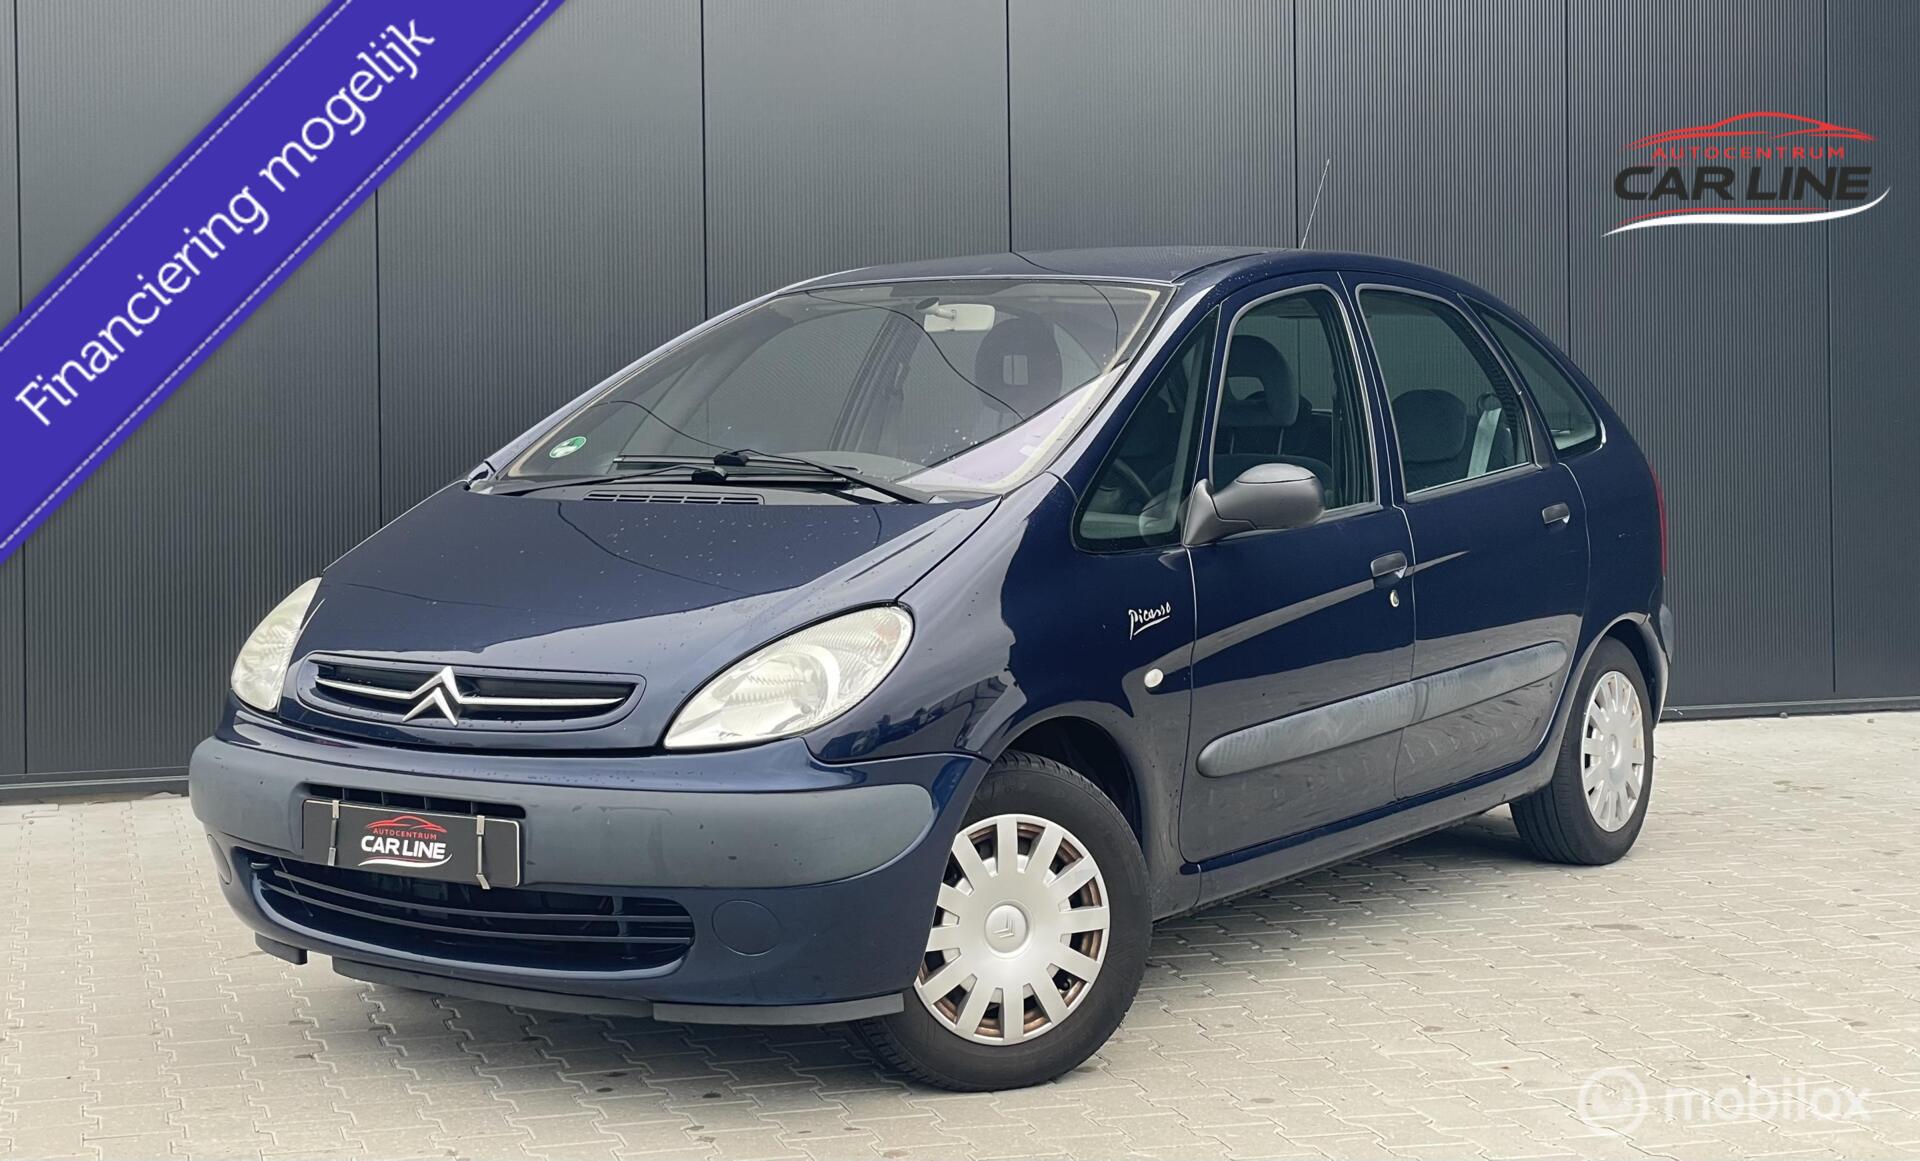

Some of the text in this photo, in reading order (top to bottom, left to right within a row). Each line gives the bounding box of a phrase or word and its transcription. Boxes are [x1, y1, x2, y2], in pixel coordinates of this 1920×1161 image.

[1128, 601, 1171, 641] Picasso
[373, 828, 437, 840] AUTOCENTRUM
[360, 835, 447, 860] CAR LINE
